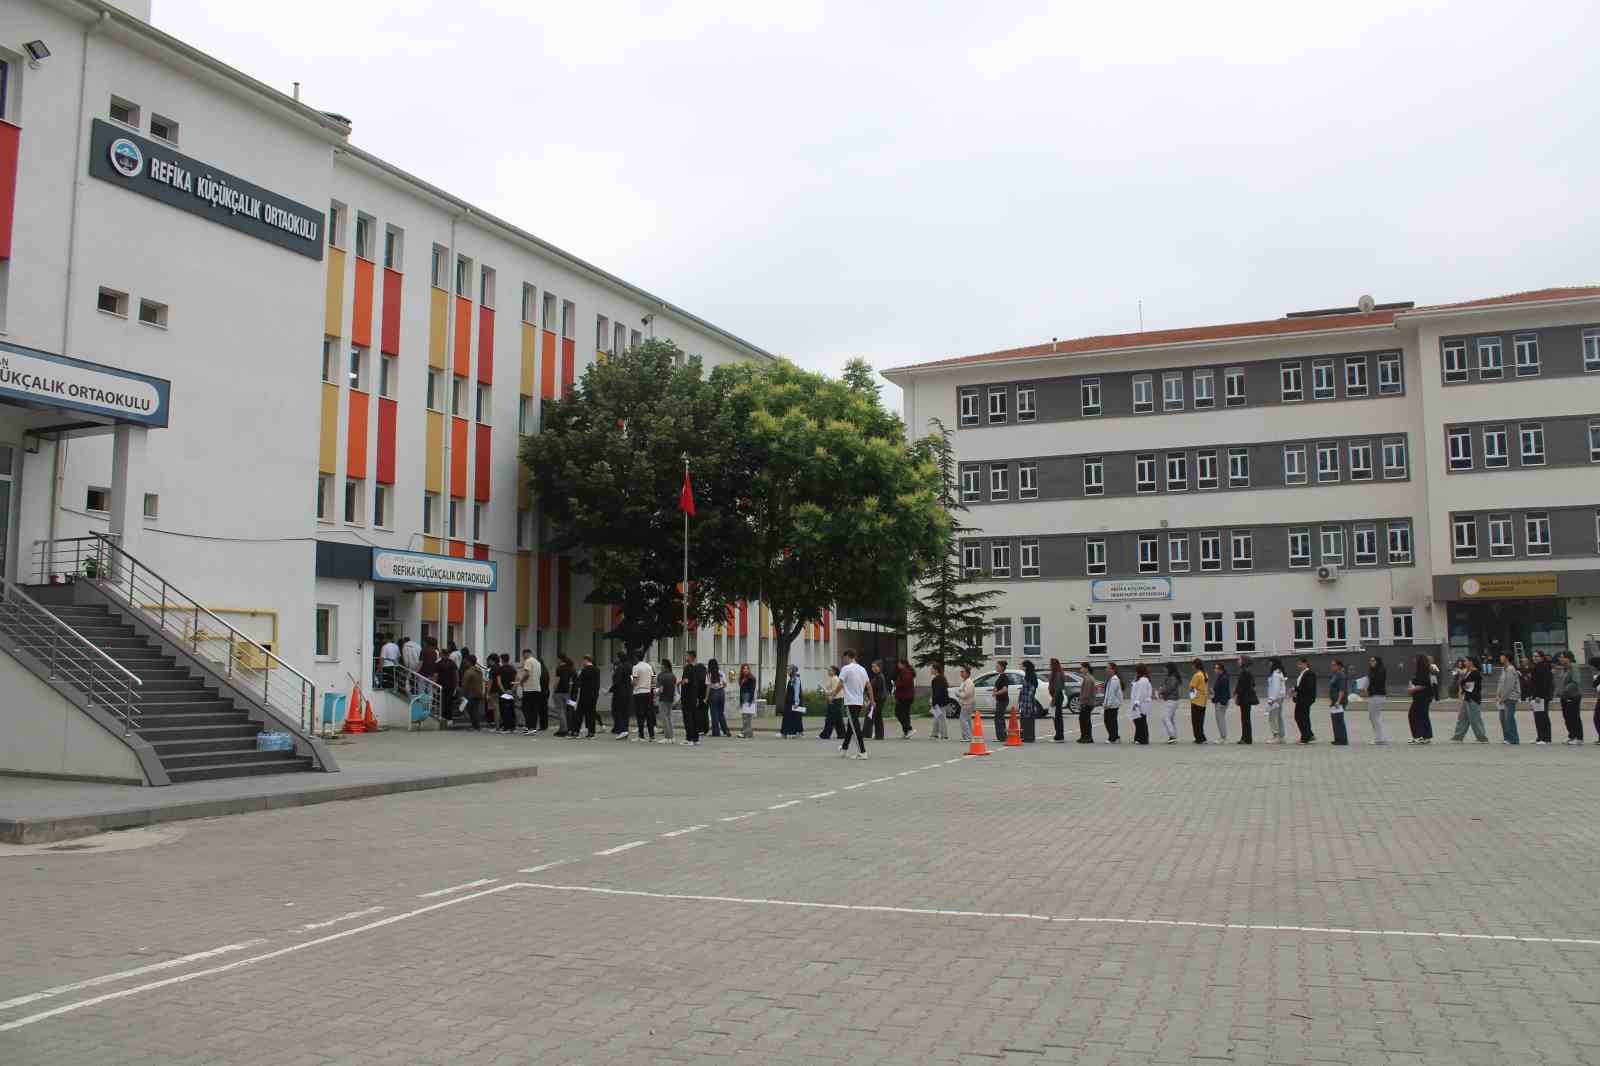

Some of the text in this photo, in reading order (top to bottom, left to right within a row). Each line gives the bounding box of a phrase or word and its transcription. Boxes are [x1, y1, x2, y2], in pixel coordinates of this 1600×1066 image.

[151, 157, 192, 192] REFİKA
[197, 174, 261, 219] KÜÇÜKÇALIK
[264, 203, 317, 241] ORTAOKULU
[68, 384, 150, 411] ORTAOKULU
